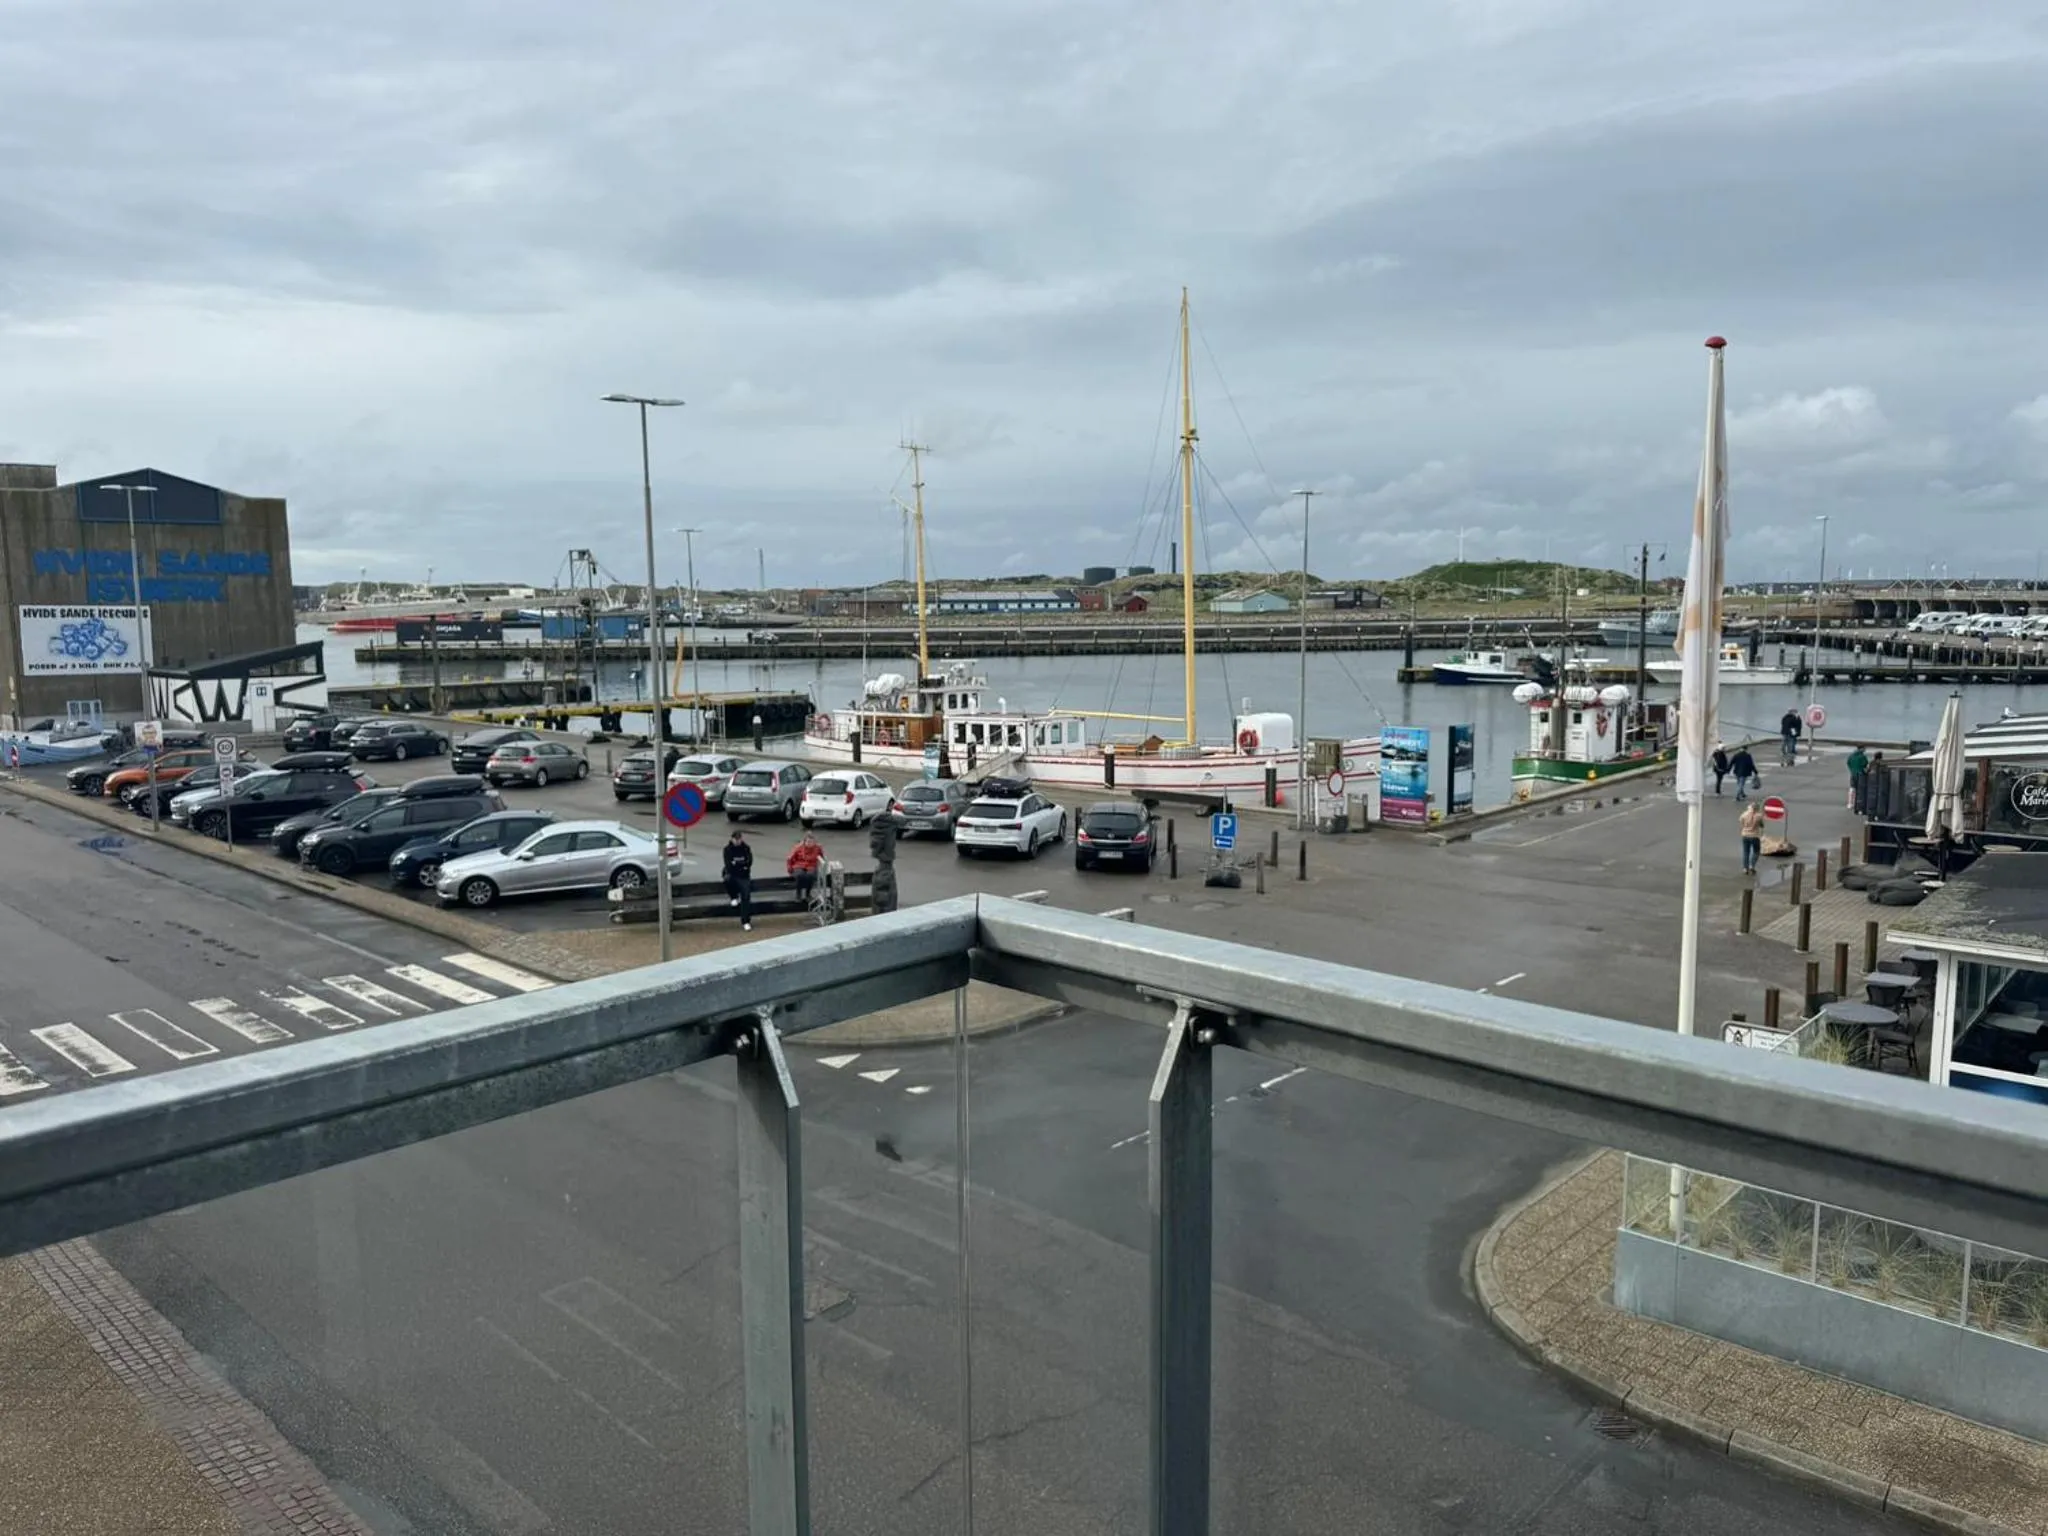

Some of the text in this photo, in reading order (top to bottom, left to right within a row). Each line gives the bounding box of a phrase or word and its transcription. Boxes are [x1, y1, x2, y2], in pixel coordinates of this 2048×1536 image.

[158, 550, 272, 575] SANDE
[22, 607, 149, 619] HVIDE SANDE ICECUBS
[1218, 816, 1232, 835] P
